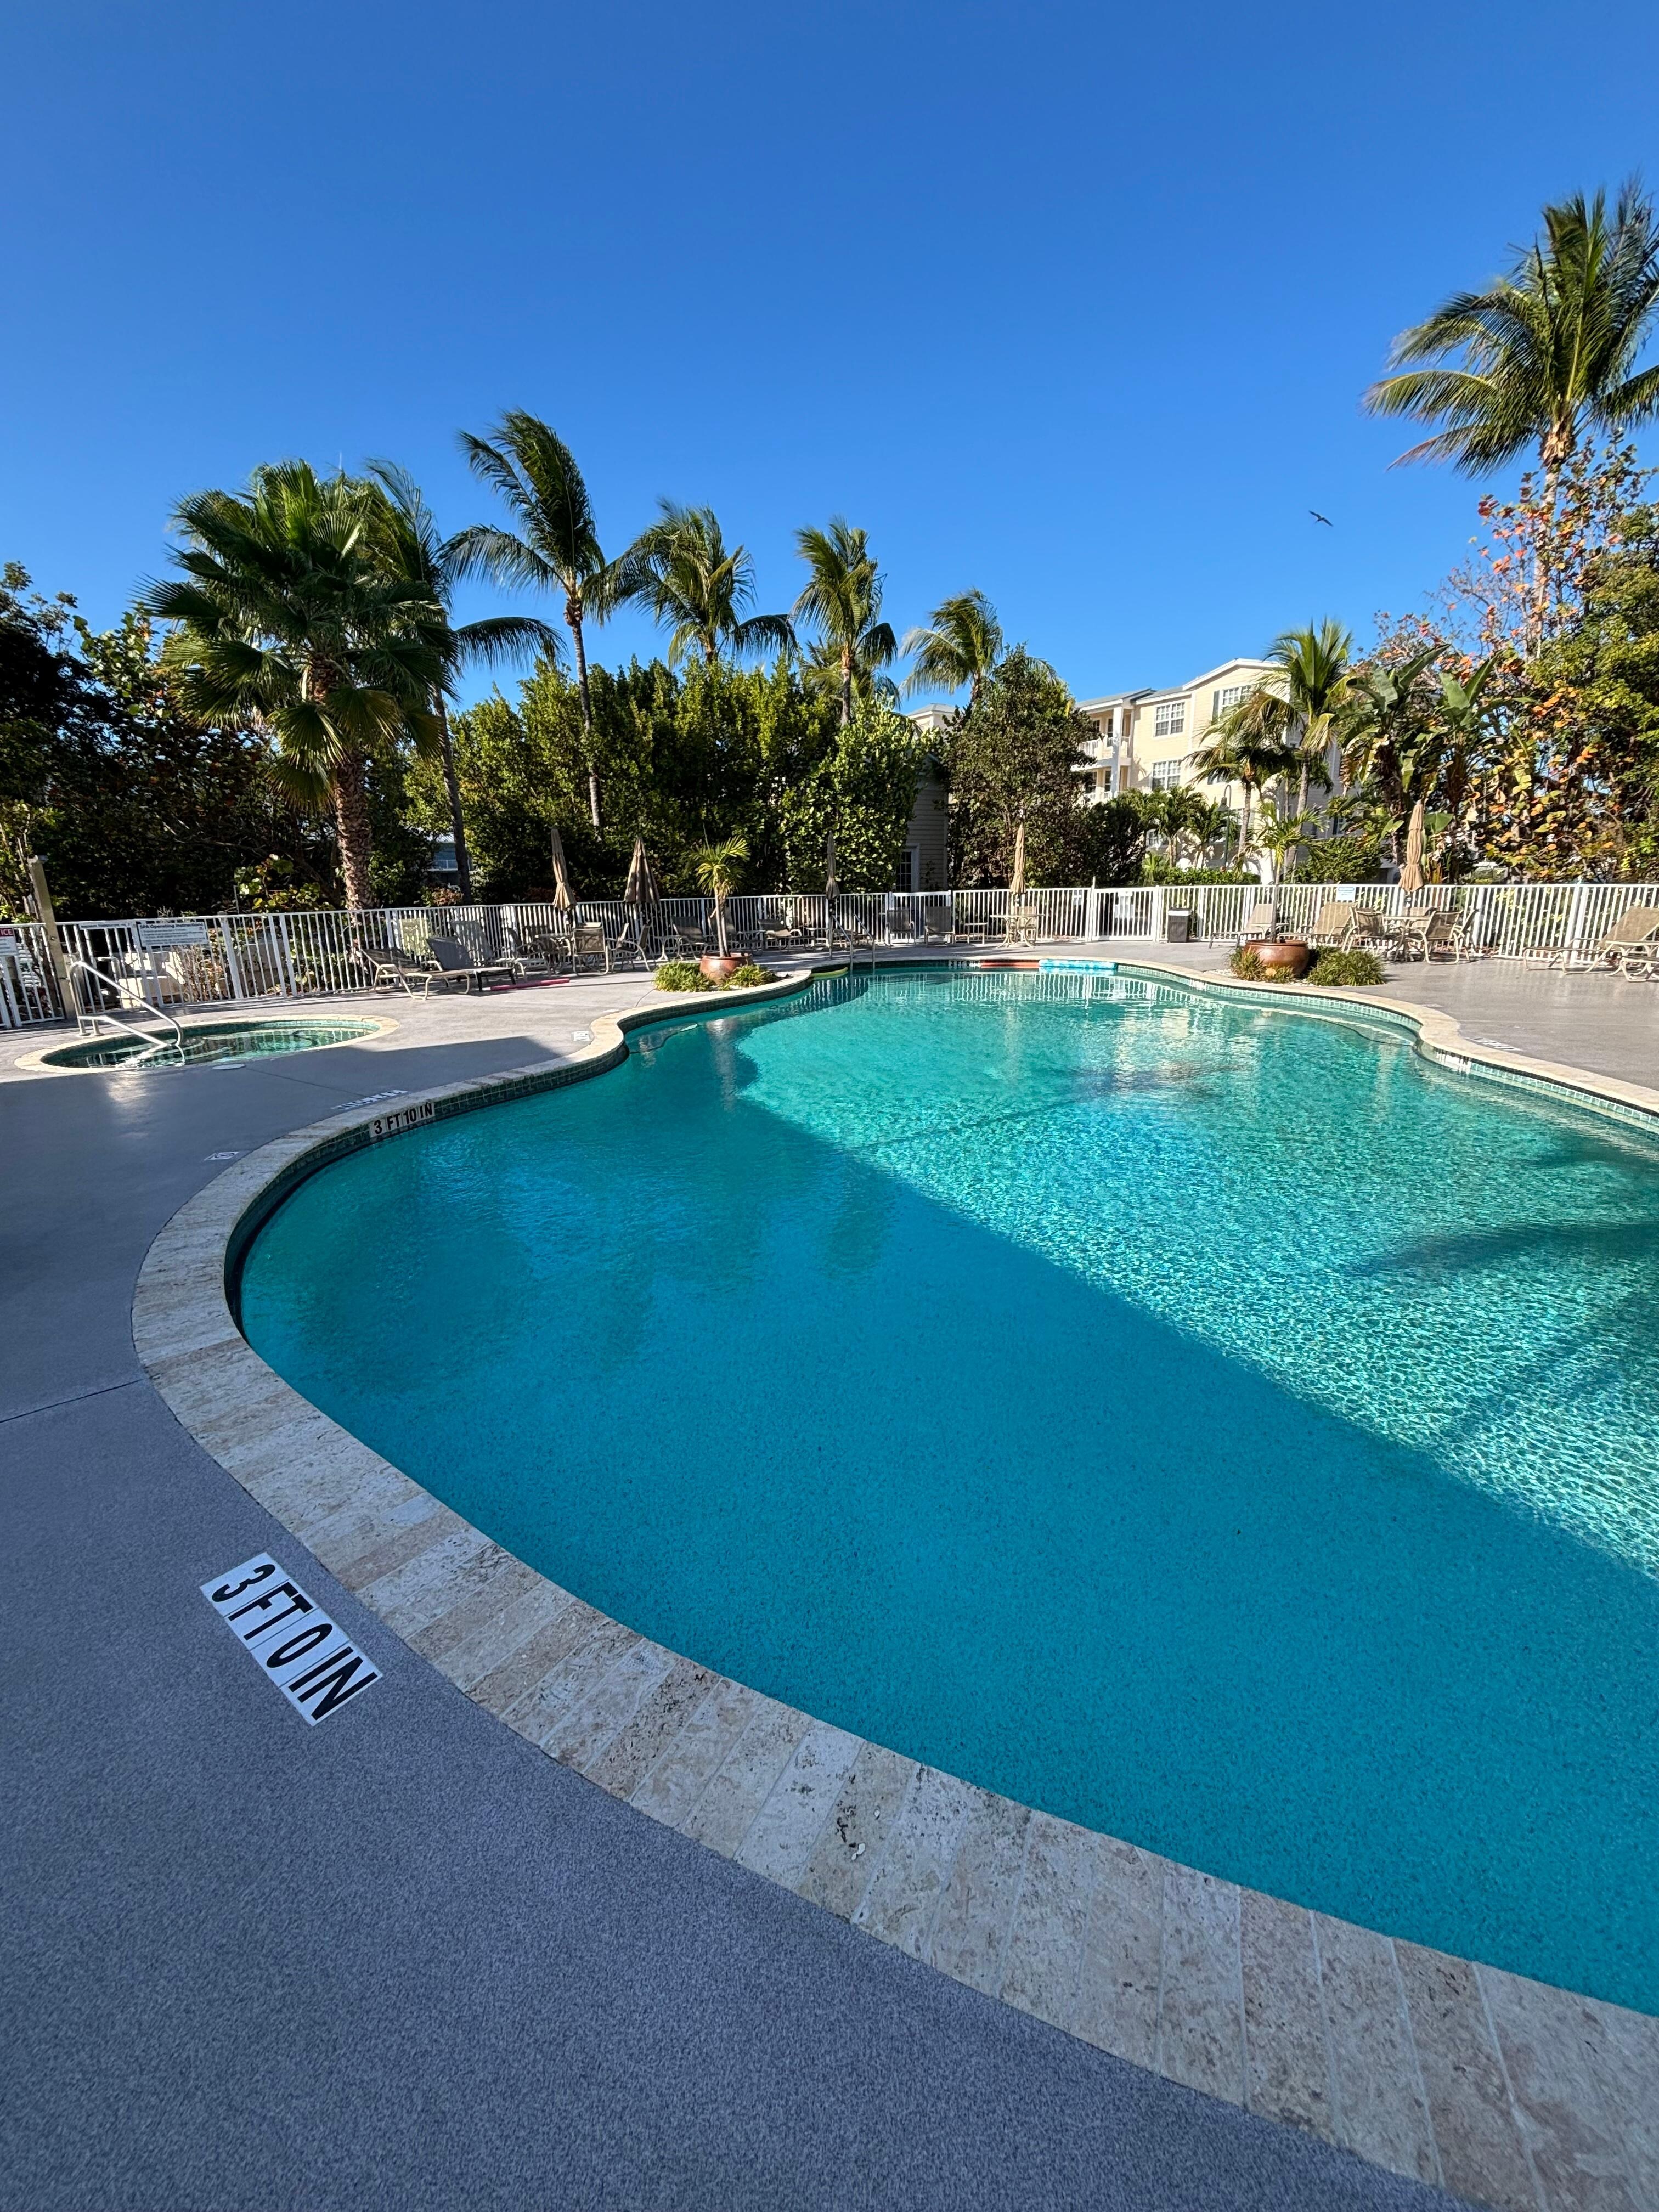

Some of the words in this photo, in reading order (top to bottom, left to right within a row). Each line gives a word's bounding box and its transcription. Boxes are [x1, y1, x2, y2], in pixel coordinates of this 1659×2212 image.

[374, 1120, 383, 1135] 3
[387, 1113, 400, 1130] FT
[403, 1108, 417, 1124] 10
[420, 1102, 433, 1118] IN
[211, 1564, 276, 1602] 3
[228, 1582, 314, 1640] FT
[267, 1623, 333, 1668] 0
[288, 1646, 379, 1720] IN
